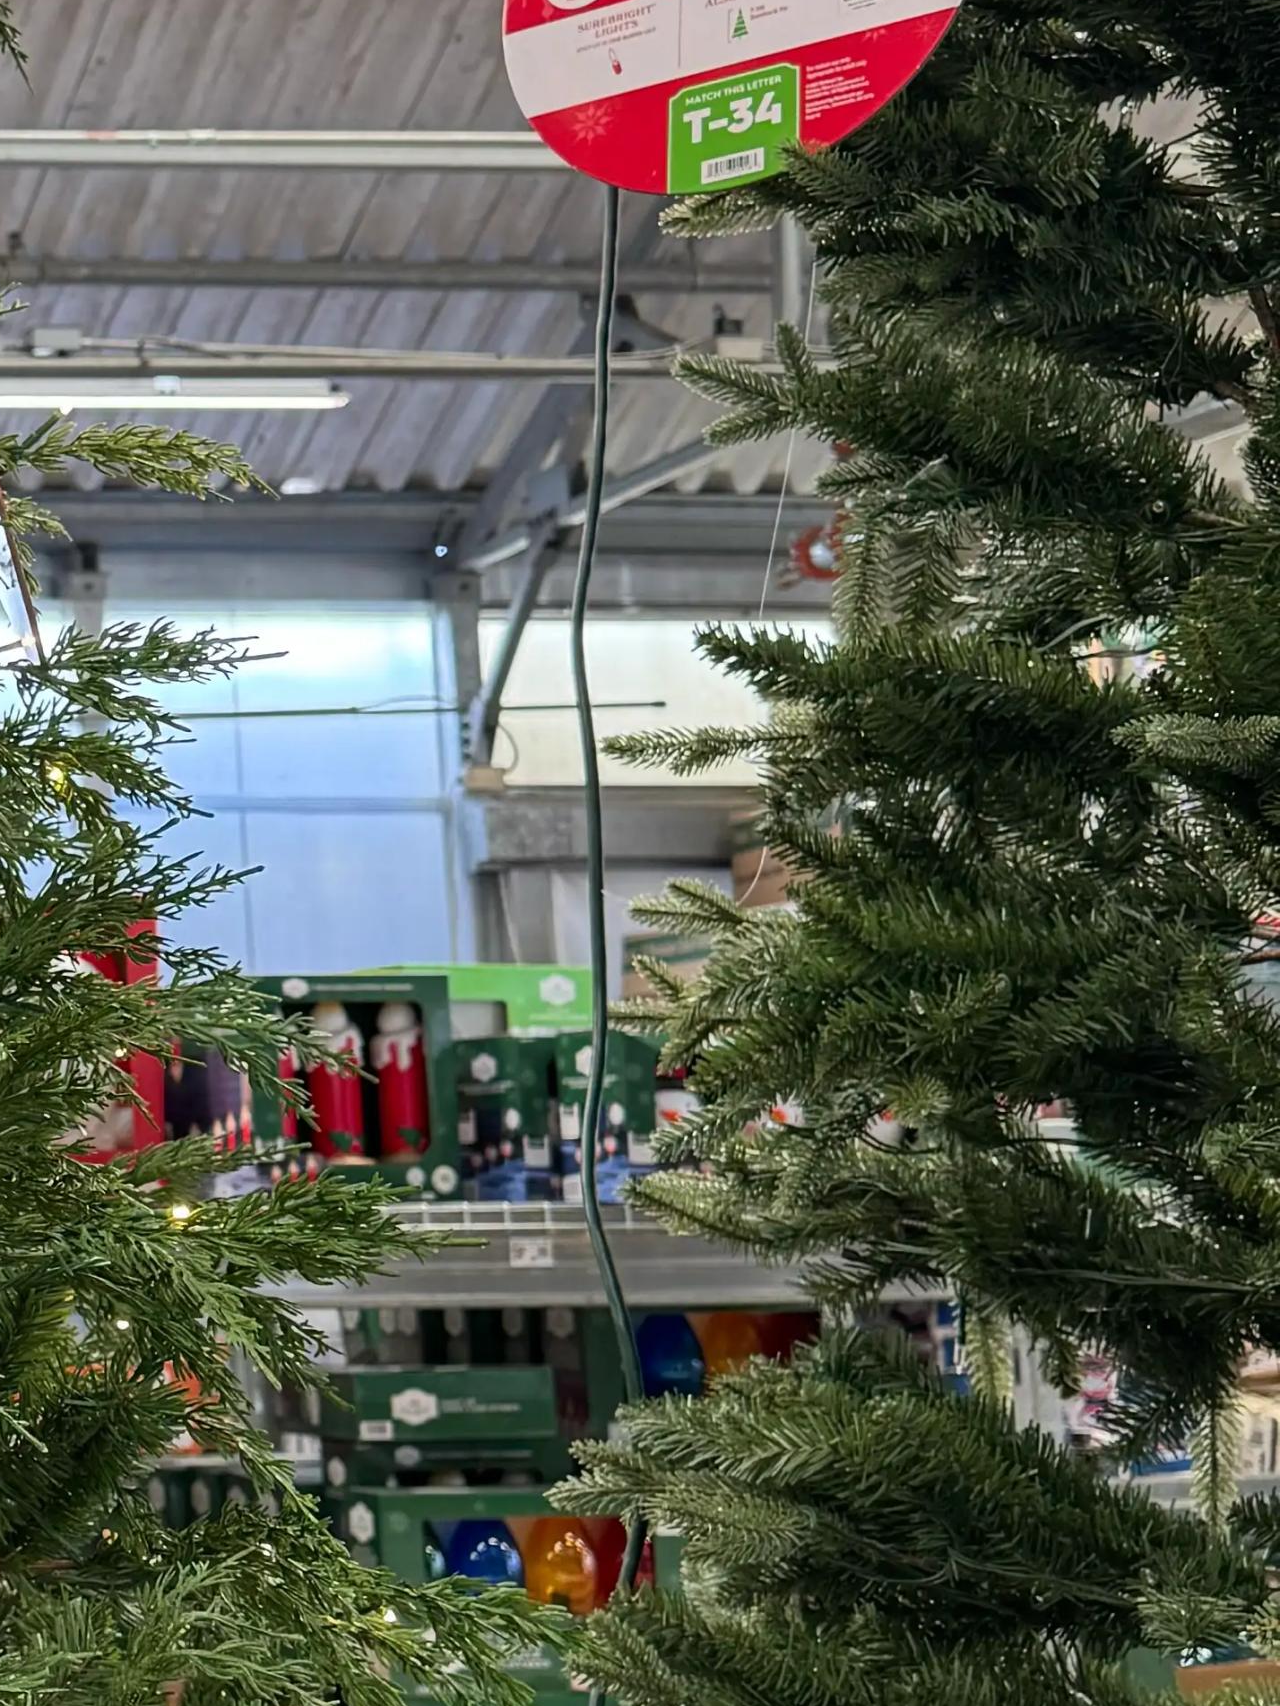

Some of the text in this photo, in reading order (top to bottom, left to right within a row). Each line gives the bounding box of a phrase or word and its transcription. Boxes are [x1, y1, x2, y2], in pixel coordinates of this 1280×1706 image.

[595, 20, 639, 39] LIGHTS
[685, 75, 782, 107] MATCH THIS LETTER
[682, 91, 782, 143] T-34
